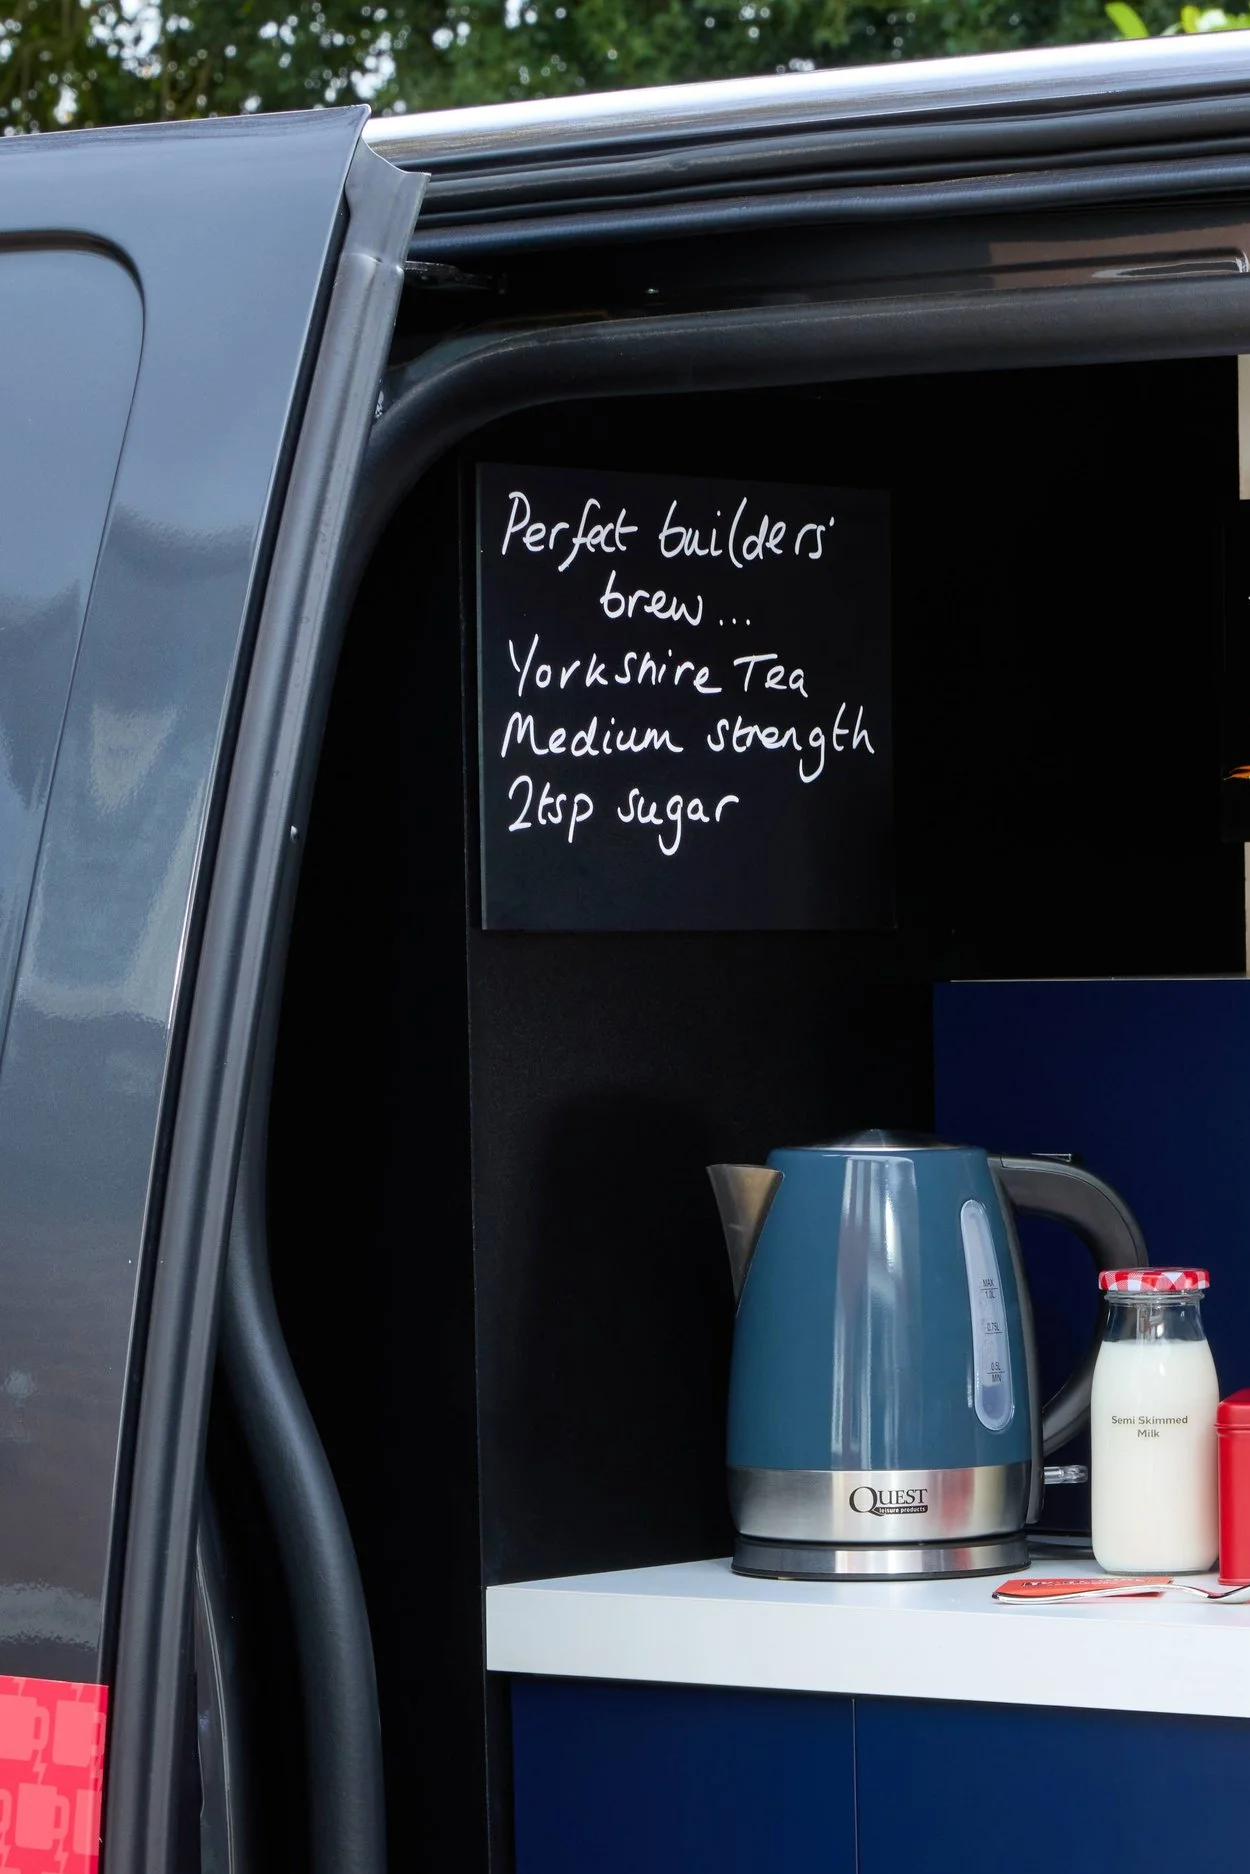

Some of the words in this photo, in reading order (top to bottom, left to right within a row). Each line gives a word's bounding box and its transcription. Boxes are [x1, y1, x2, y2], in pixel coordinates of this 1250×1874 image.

[502, 491, 638, 571] Perfect
[509, 634, 722, 697] Yorkshire
[733, 653, 809, 698] Tea
[501, 711, 684, 758] Medium
[706, 702, 875, 783] strength
[508, 775, 594, 844] 2tsp
[617, 788, 740, 856] sugar
[982, 1279, 994, 1287] MAX
[1111, 1415, 1136, 1424] Semi
[1138, 1415, 1188, 1425] Skimmed
[1137, 1428, 1160, 1438] Milk
[900, 1505, 926, 1513] products
